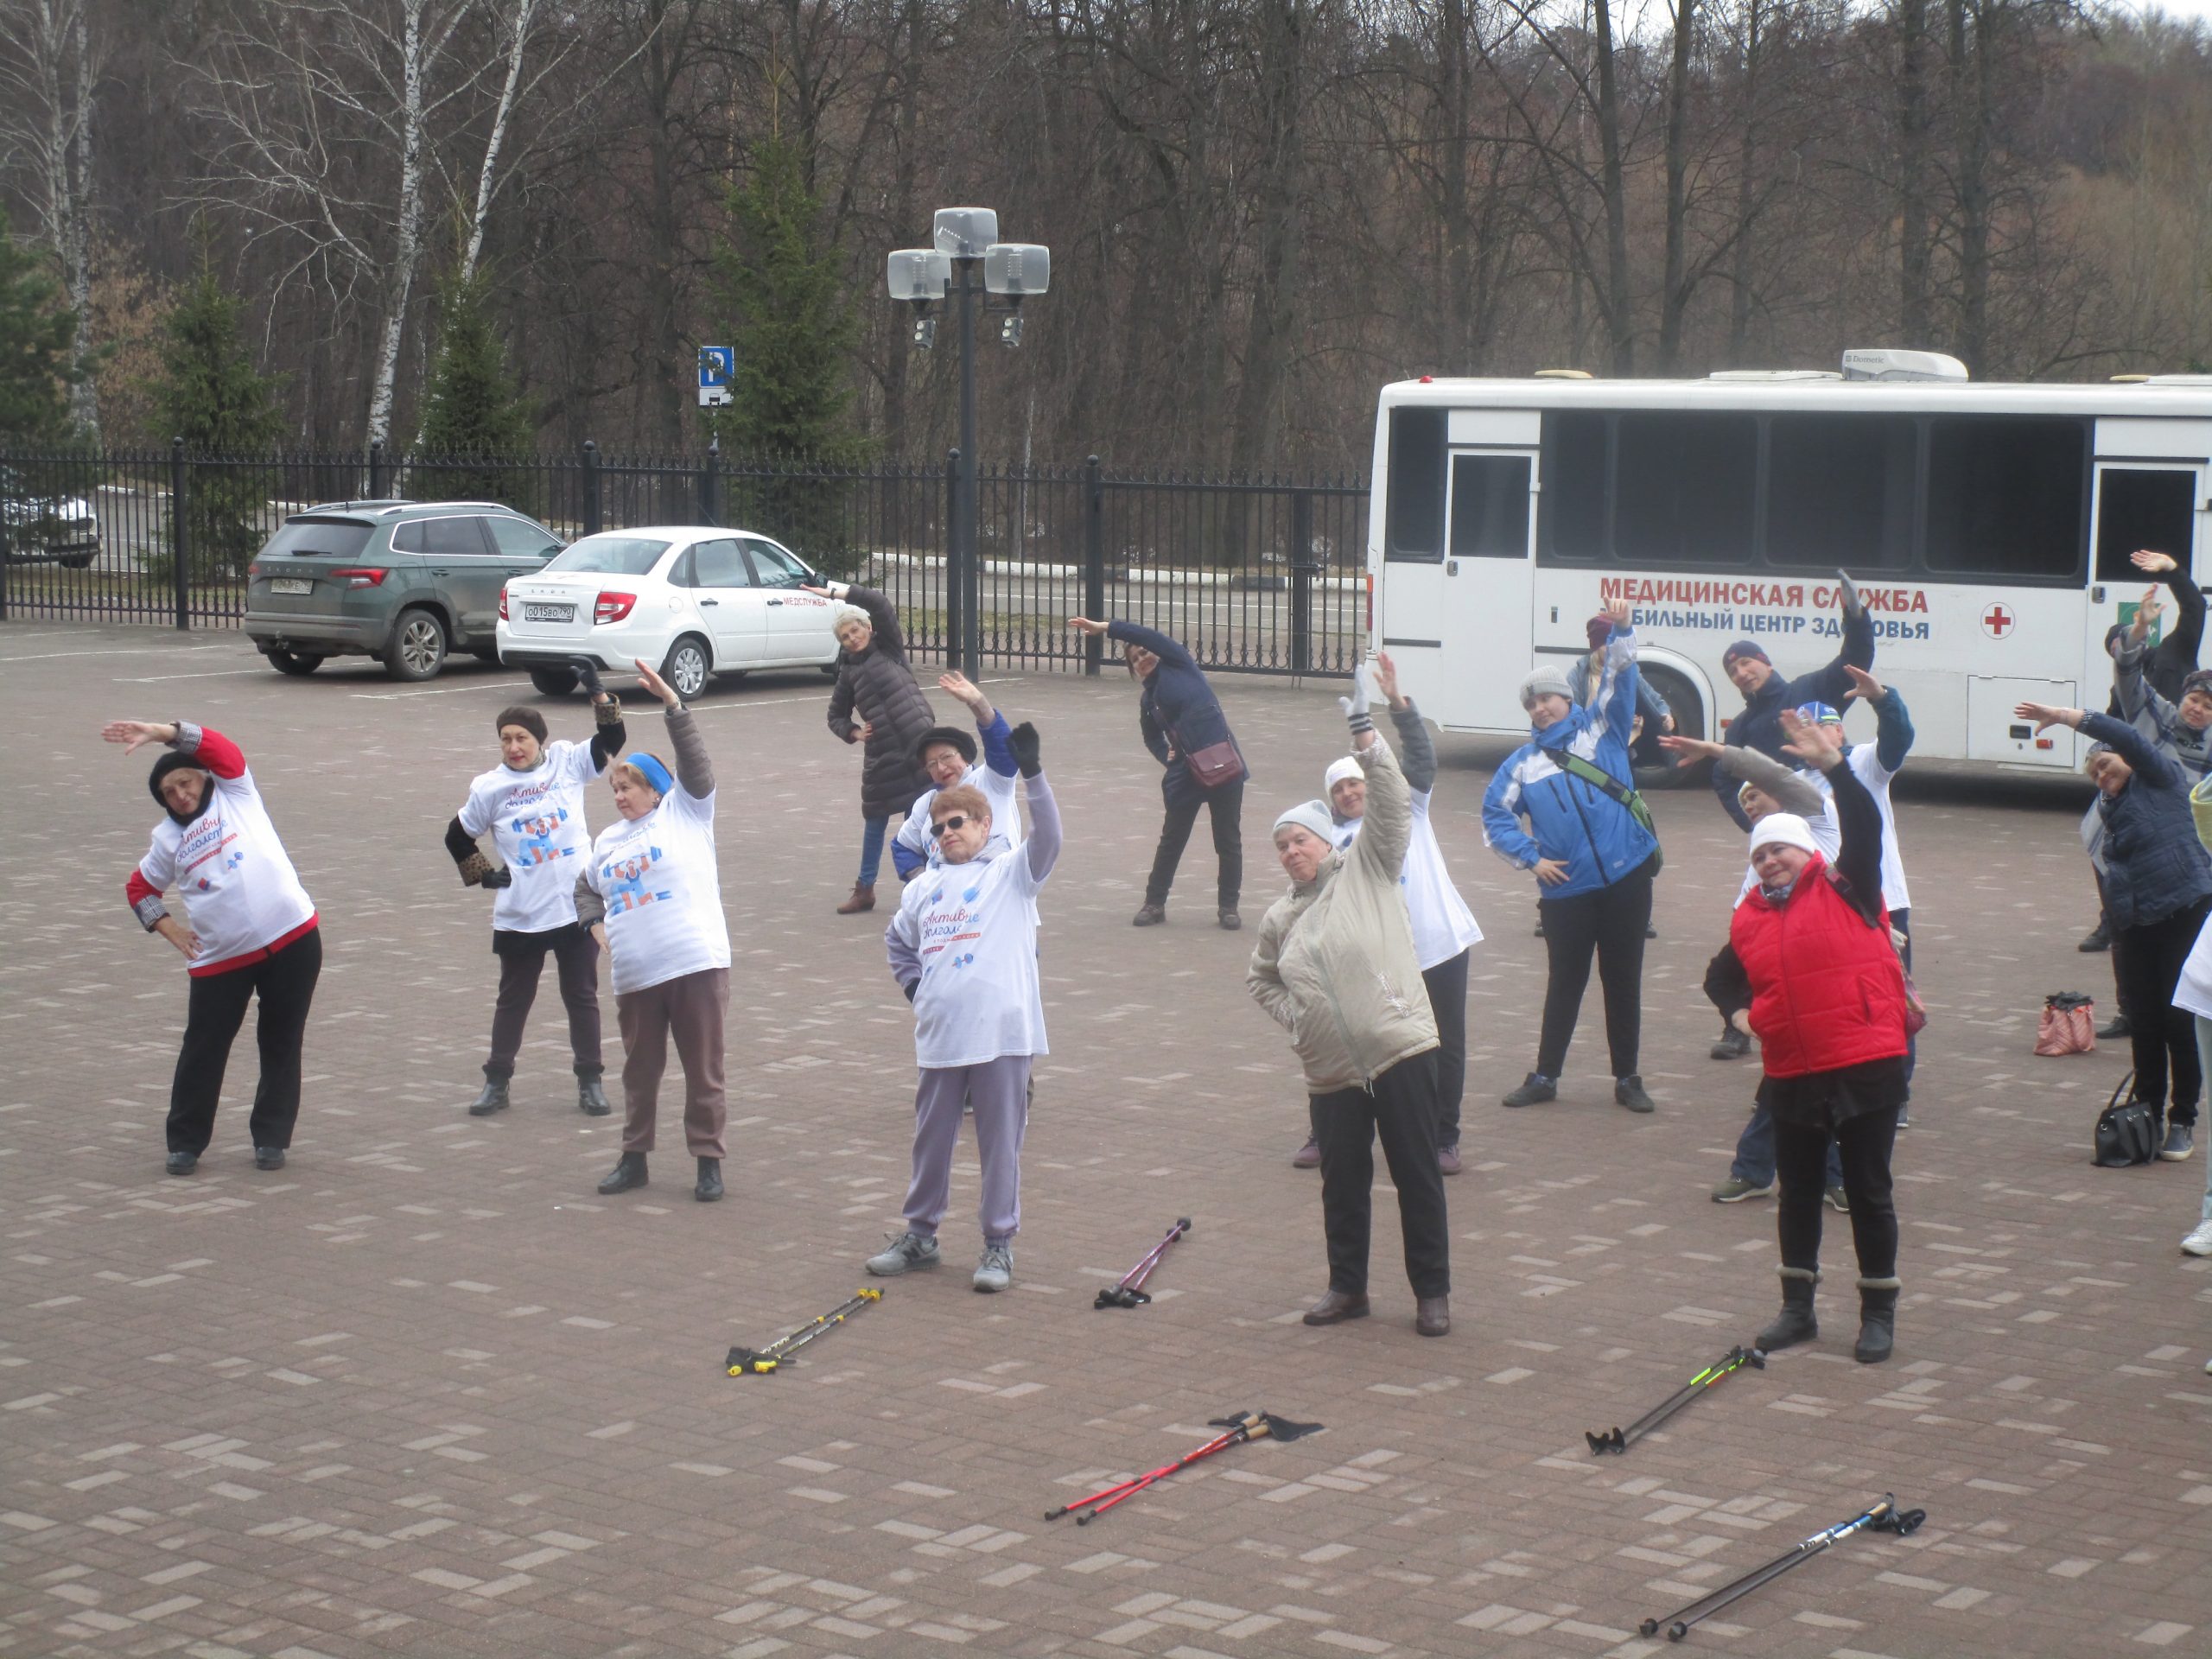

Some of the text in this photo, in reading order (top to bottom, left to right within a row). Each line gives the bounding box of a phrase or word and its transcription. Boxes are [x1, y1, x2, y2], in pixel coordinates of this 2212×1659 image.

[783, 597, 828, 607] МЕДСЛУЖБА
[1600, 577, 1803, 607] МЕДИЦИНСКАЯ
[1600, 607, 1929, 640] БИЛЬНЫЙ ЦЕНТР ЗДОВЬЯ
